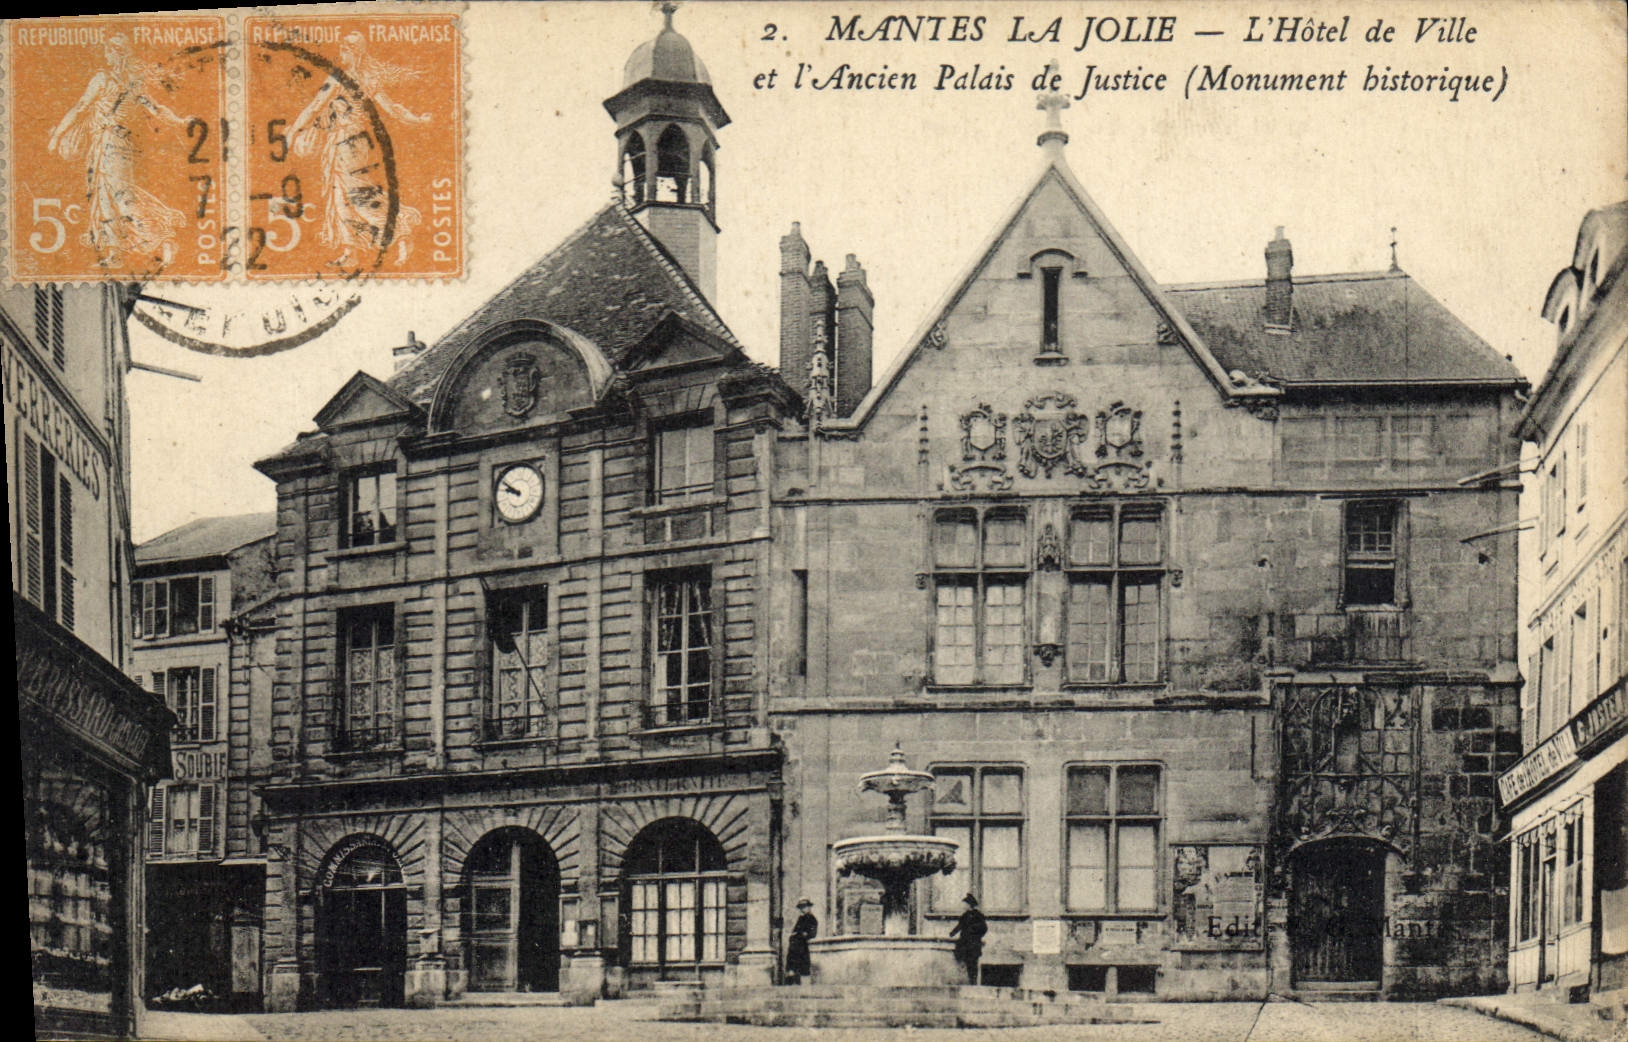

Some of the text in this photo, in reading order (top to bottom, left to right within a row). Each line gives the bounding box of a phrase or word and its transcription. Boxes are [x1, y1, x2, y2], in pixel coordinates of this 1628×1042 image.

[132, 25, 216, 46] FRANÇAISE
[368, 23, 451, 45] FRANÇAISE
[432, 176, 452, 262] POSTES
